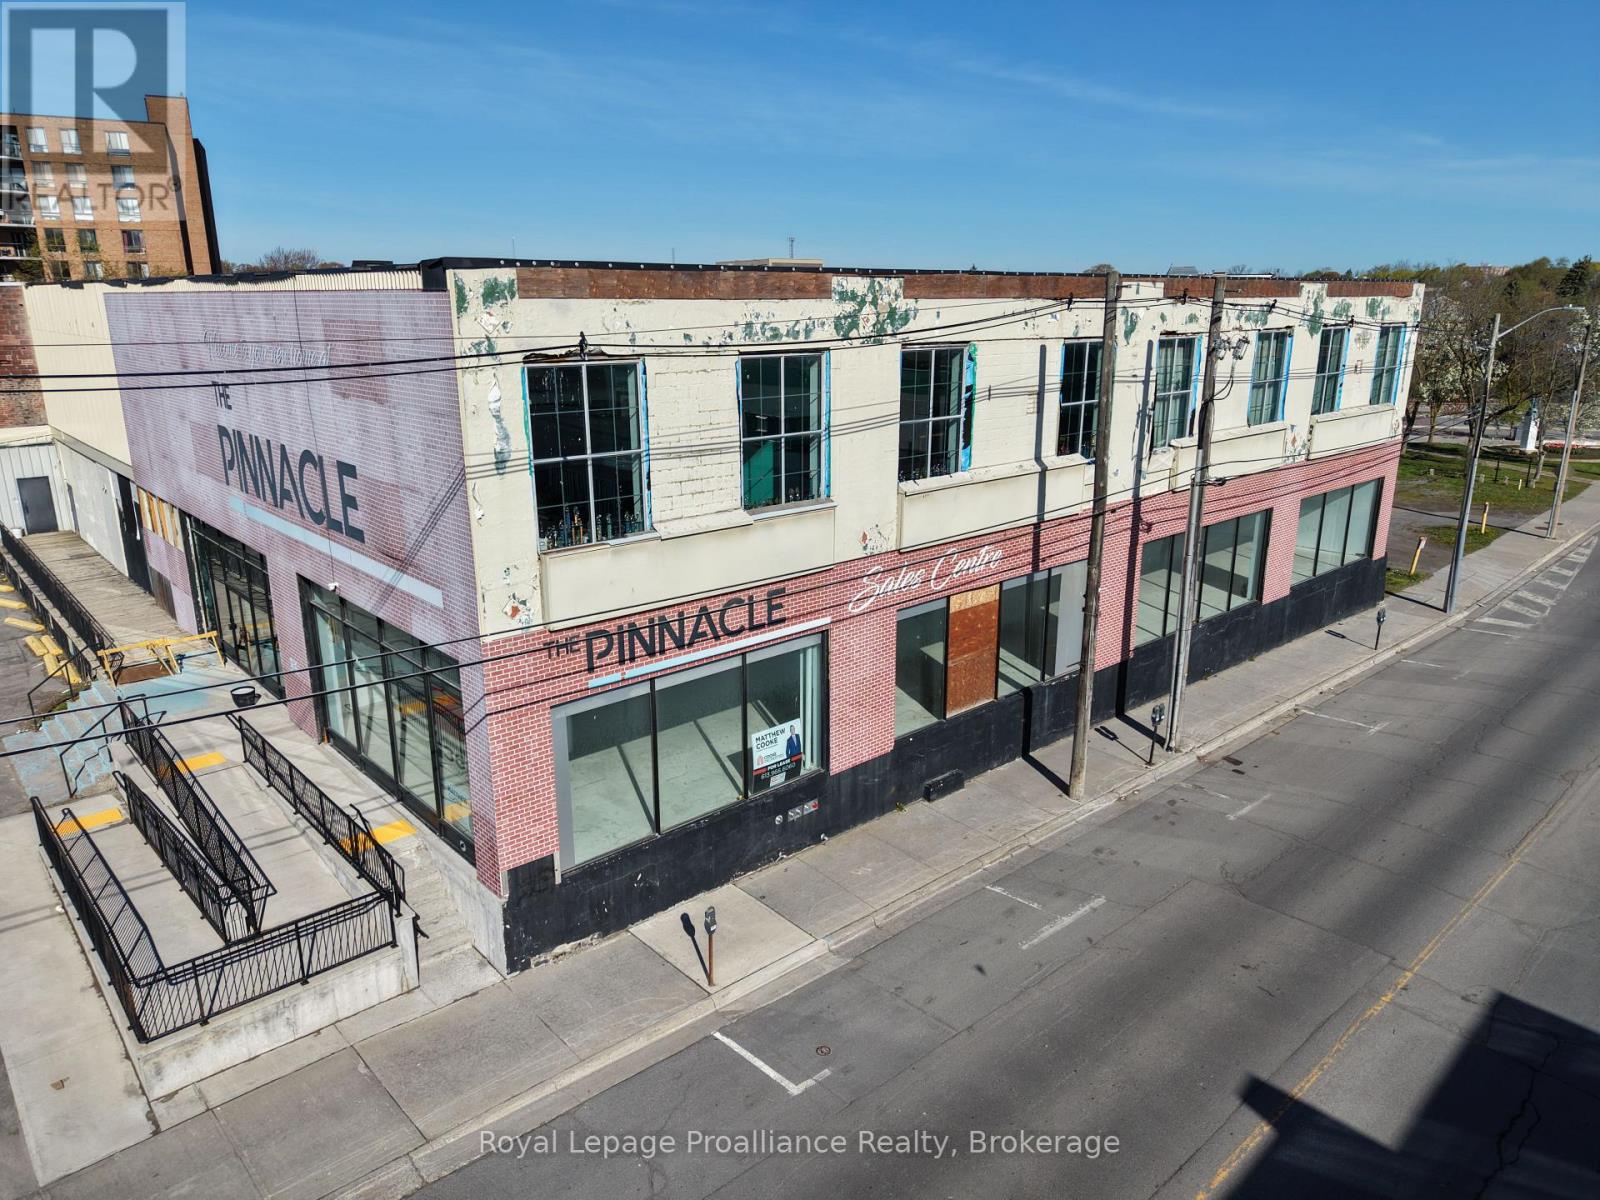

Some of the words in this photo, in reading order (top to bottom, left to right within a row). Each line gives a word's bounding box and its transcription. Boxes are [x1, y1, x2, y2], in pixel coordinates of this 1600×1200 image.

[211, 381, 232, 410] THE
[217, 424, 365, 543] PINNACLE
[849, 562, 925, 612] Sales
[931, 545, 1003, 590] Centre
[543, 634, 580, 659] THE
[586, 587, 786, 673] PINNACLE
[755, 728, 786, 743] MATTHEW
[756, 737, 778, 750] COOKE
